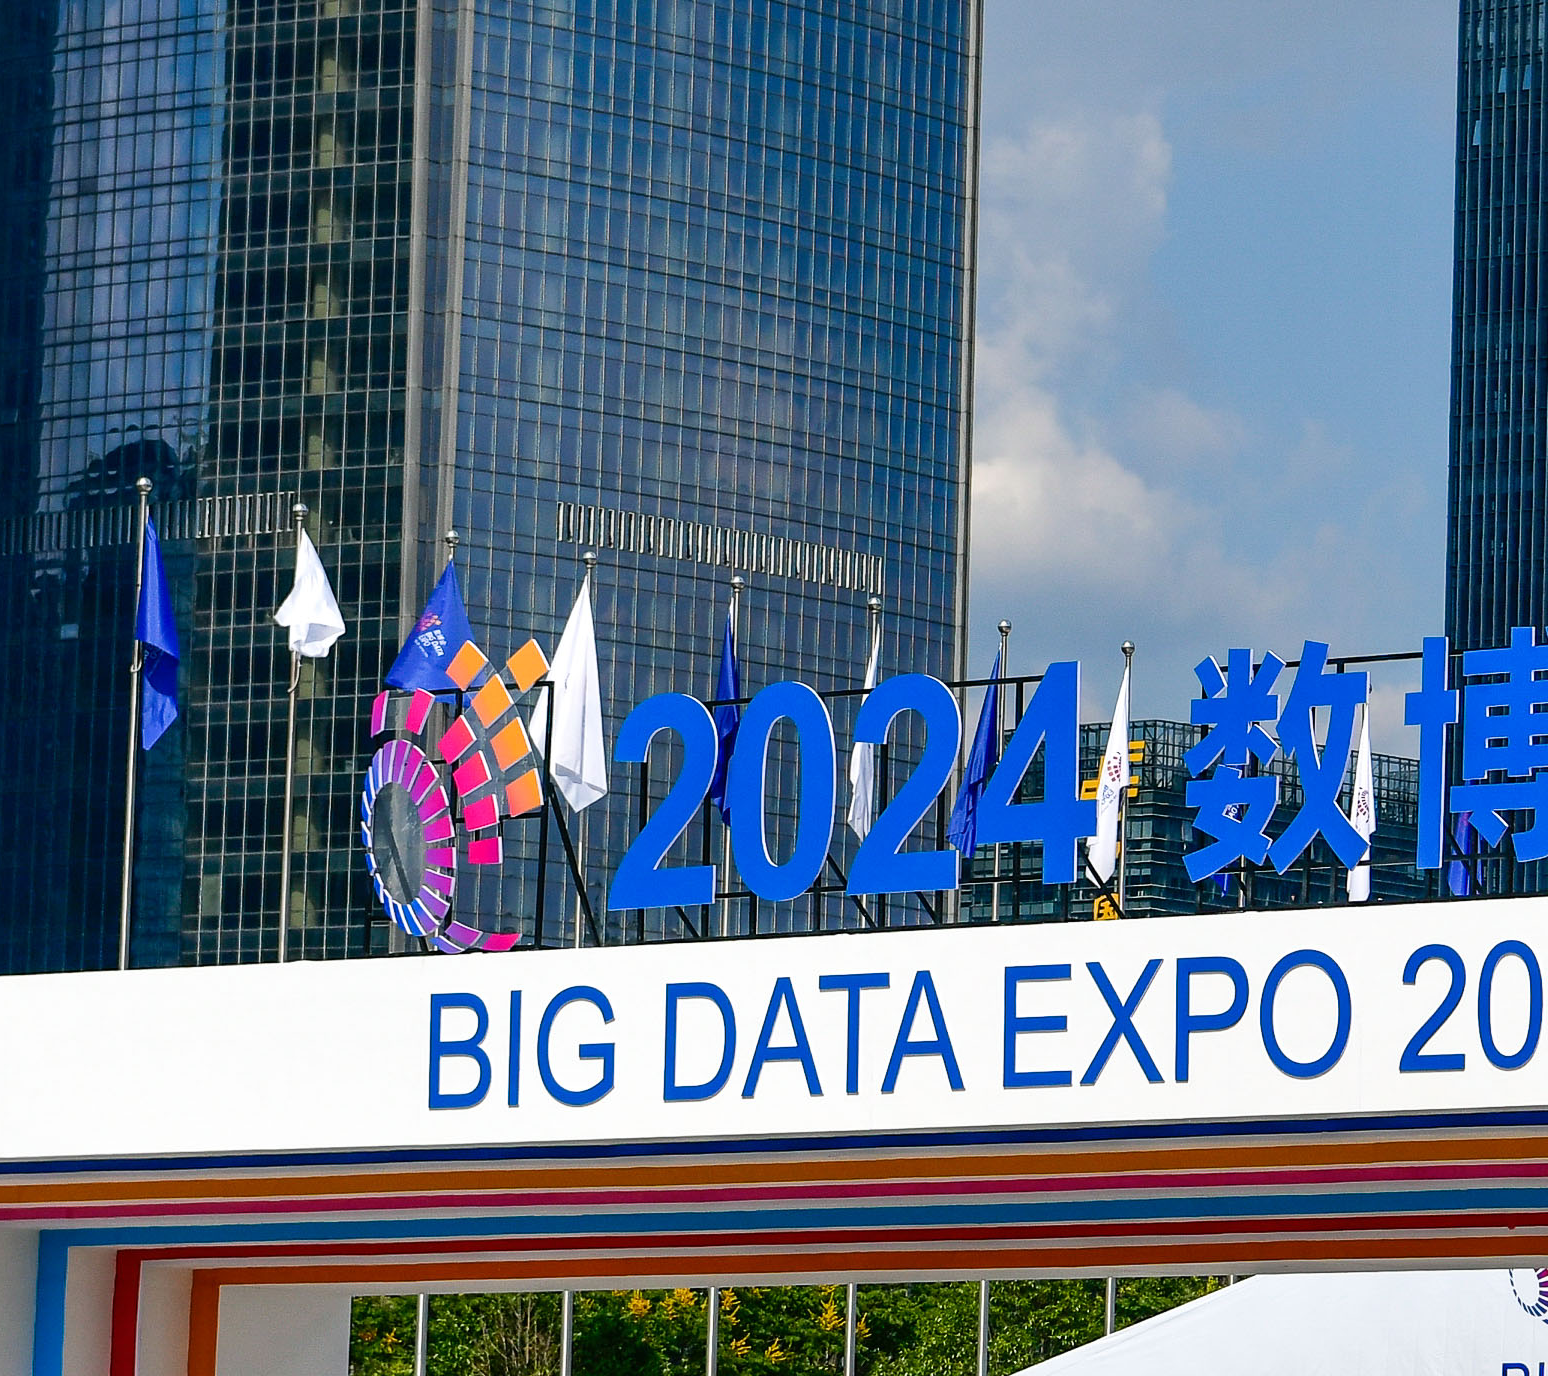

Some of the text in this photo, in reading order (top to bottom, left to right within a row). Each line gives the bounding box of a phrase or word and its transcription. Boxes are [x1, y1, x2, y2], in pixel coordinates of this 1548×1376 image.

[608, 660, 1100, 911] 2024
[428, 985, 616, 1111] BIG
[664, 970, 966, 1104] DATA
[1003, 949, 1352, 1089] EXPO
